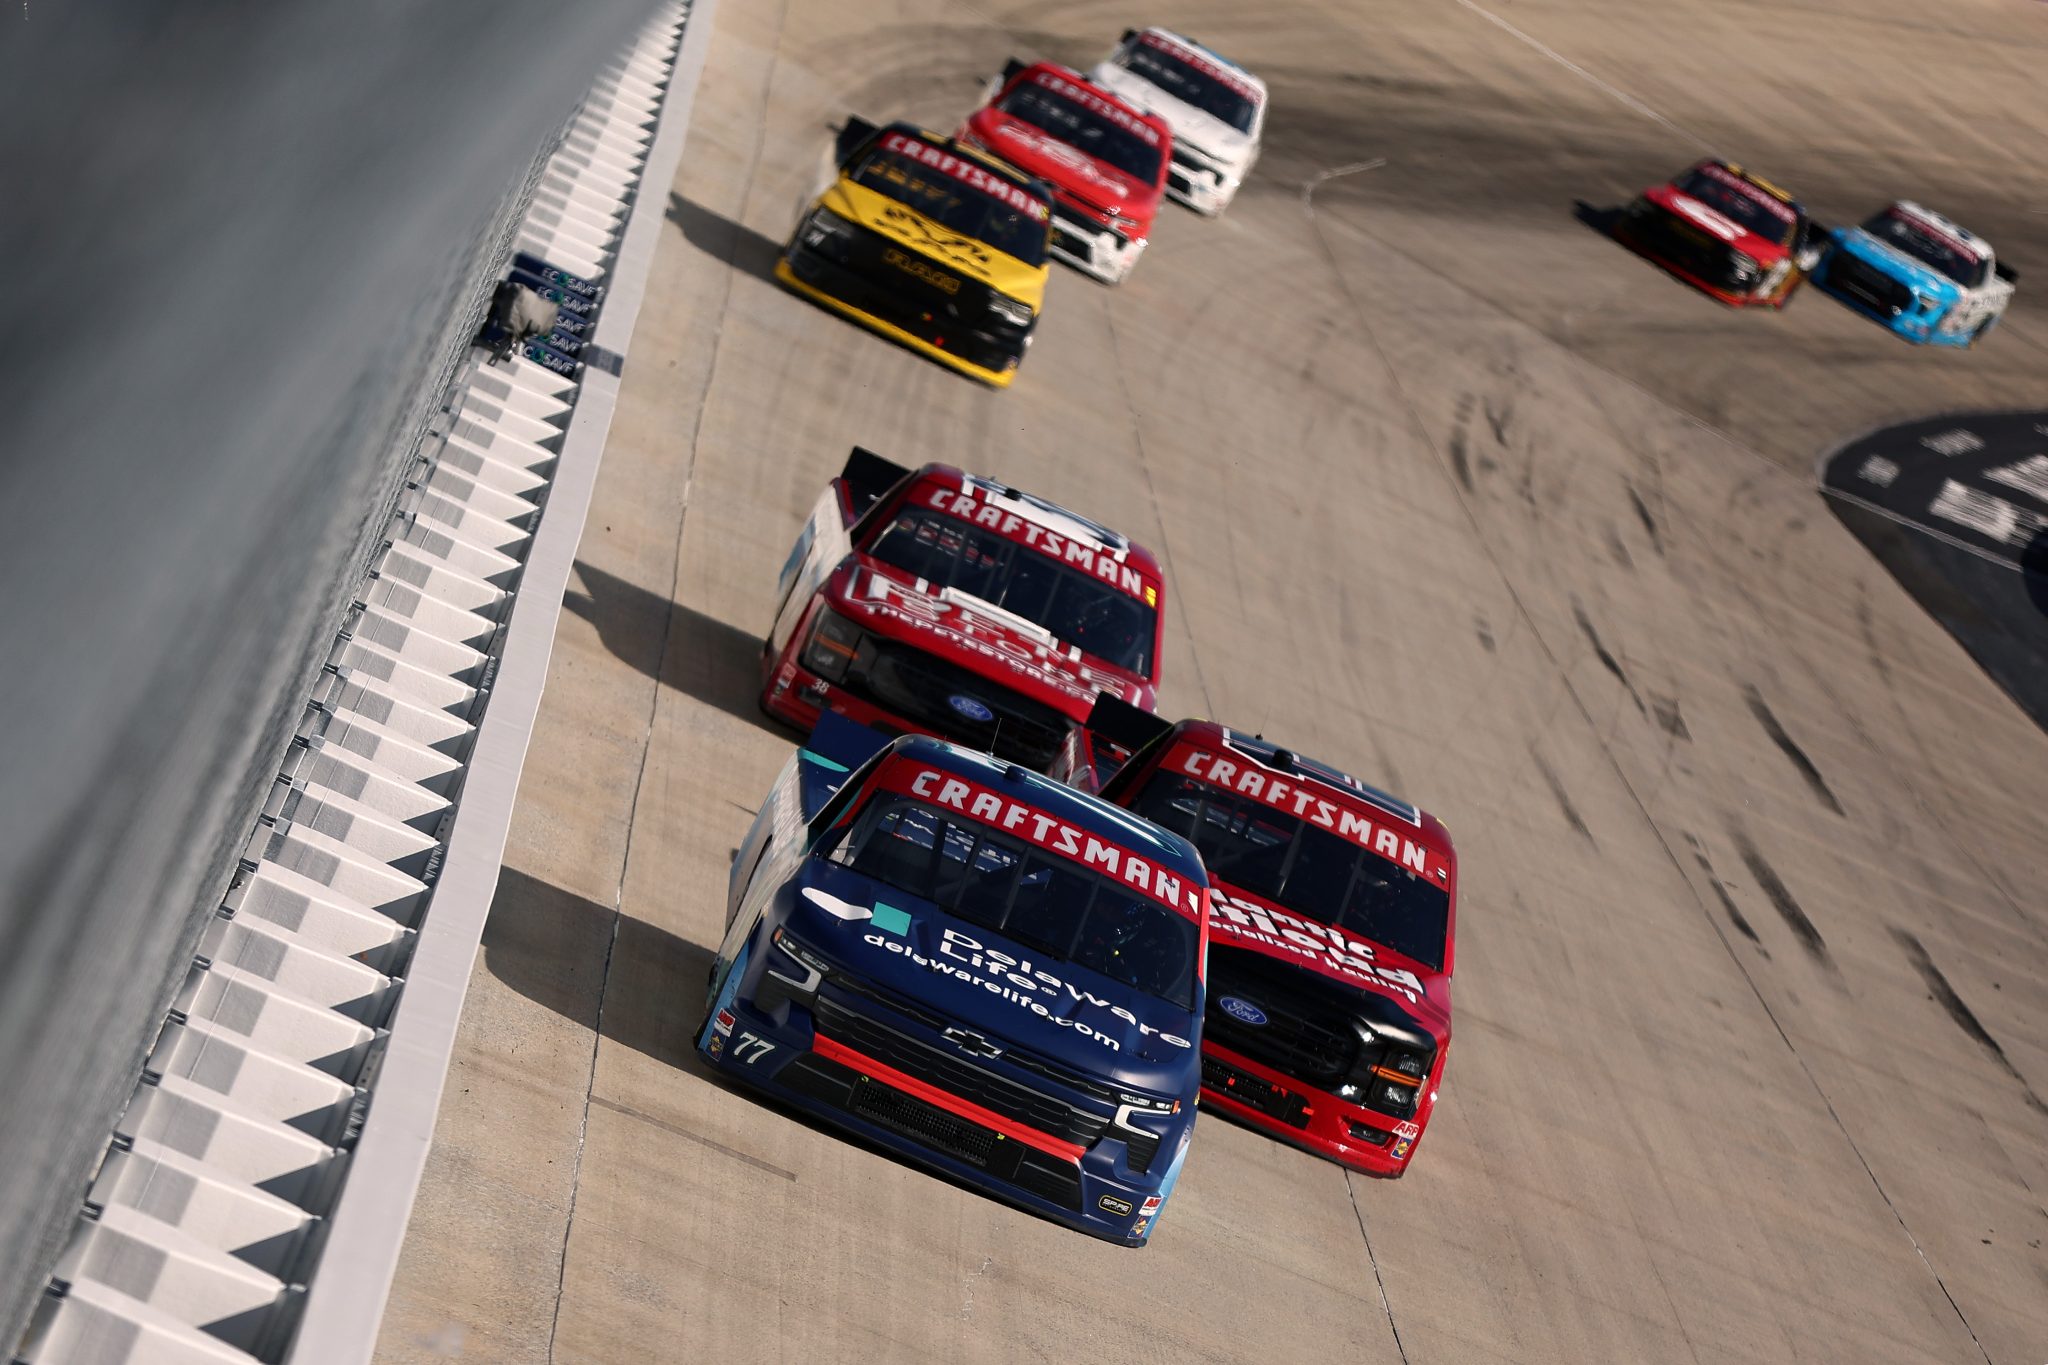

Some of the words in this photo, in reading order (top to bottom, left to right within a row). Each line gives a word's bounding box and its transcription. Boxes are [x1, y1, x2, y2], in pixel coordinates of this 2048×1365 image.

[887, 135, 1047, 222] CRAFTSMAN
[929, 489, 1142, 595] CRAFTSMAN
[911, 770, 1181, 908] CRAFTSMAN
[1184, 751, 1427, 874] CRAFTSMAN
[1208, 919, 1318, 960] ecialized
[1209, 901, 1424, 995] tload
[1210, 887, 1375, 961] lantic
[863, 934, 1121, 1052] delawarelife.com
[944, 928, 1192, 1049] Delaware
[1226, 999, 1262, 1023] Ford
[733, 1031, 776, 1065] 77
